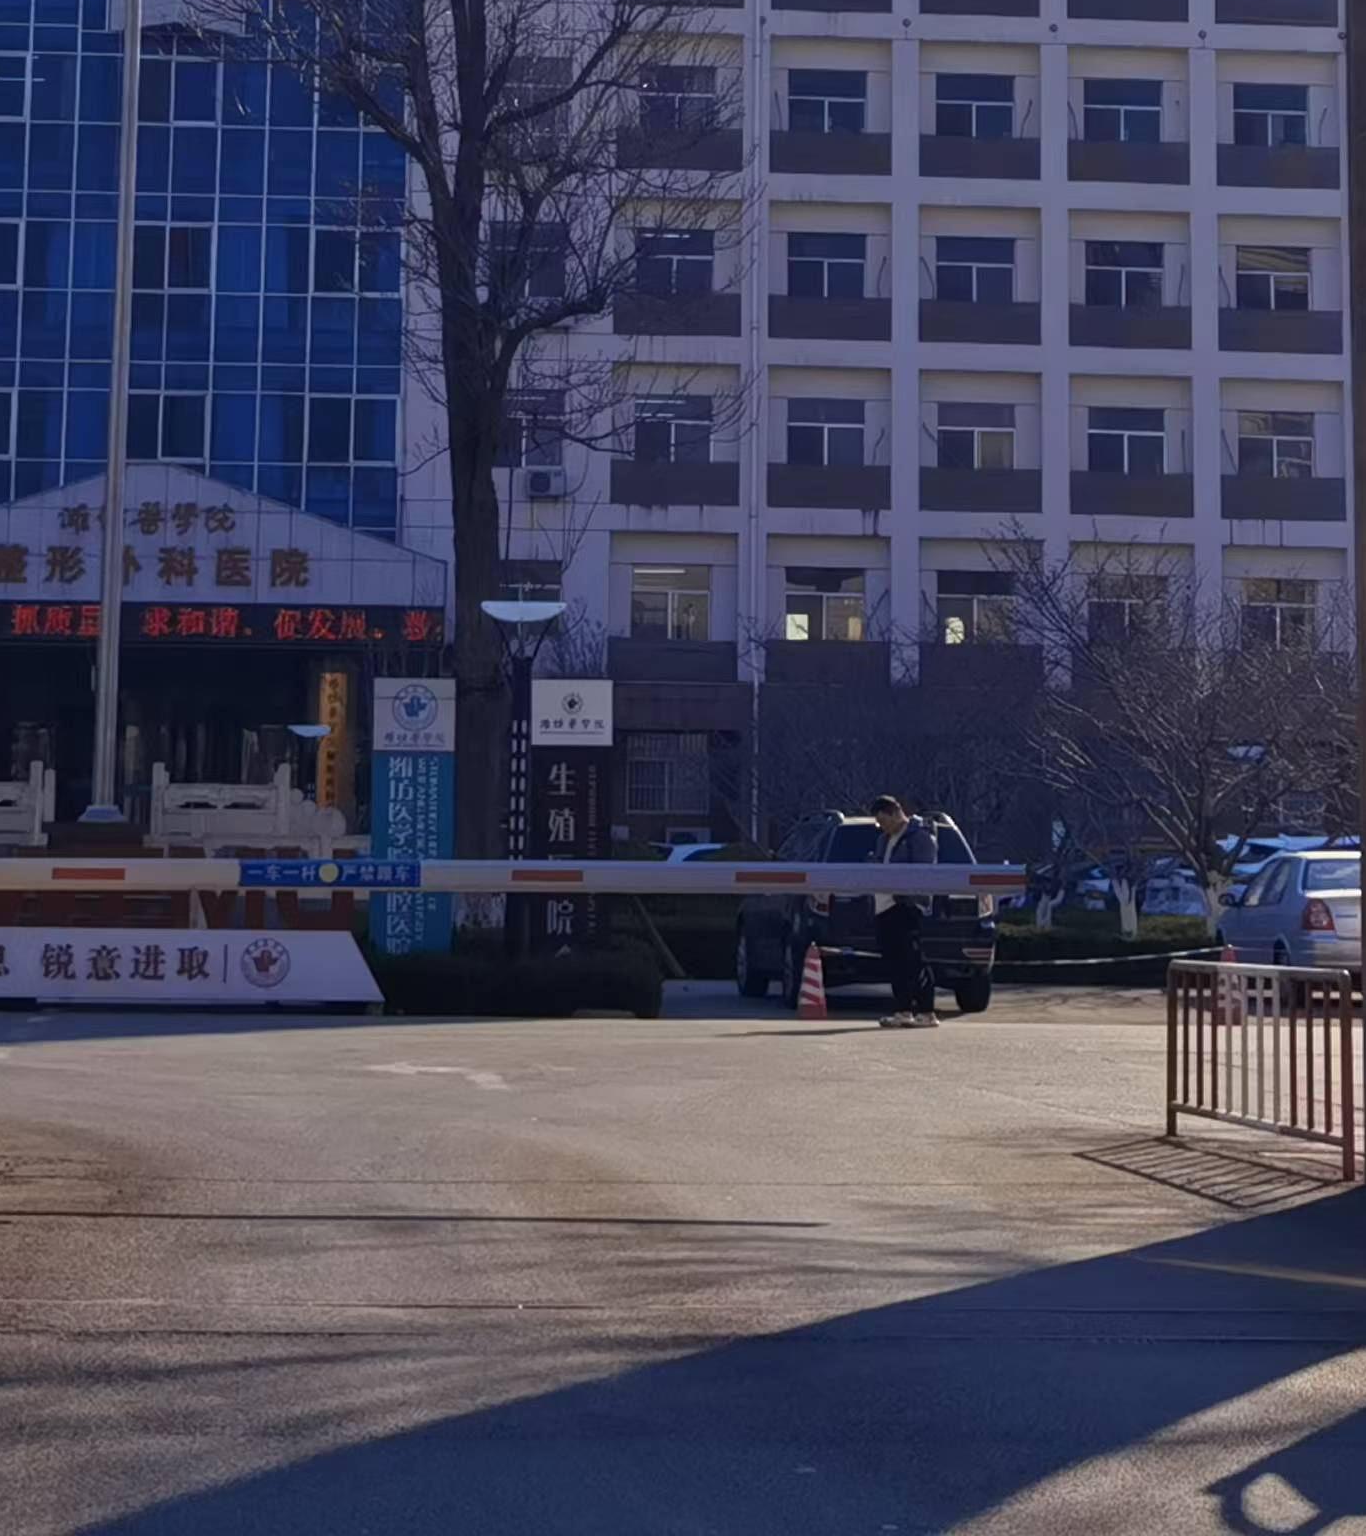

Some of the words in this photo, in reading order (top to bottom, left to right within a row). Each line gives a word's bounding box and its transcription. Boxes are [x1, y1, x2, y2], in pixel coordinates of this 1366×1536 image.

[546, 761, 577, 936] 生殖院
[247, 864, 317, 881] 一车一杆
[41, 943, 211, 982] 锐意进取
